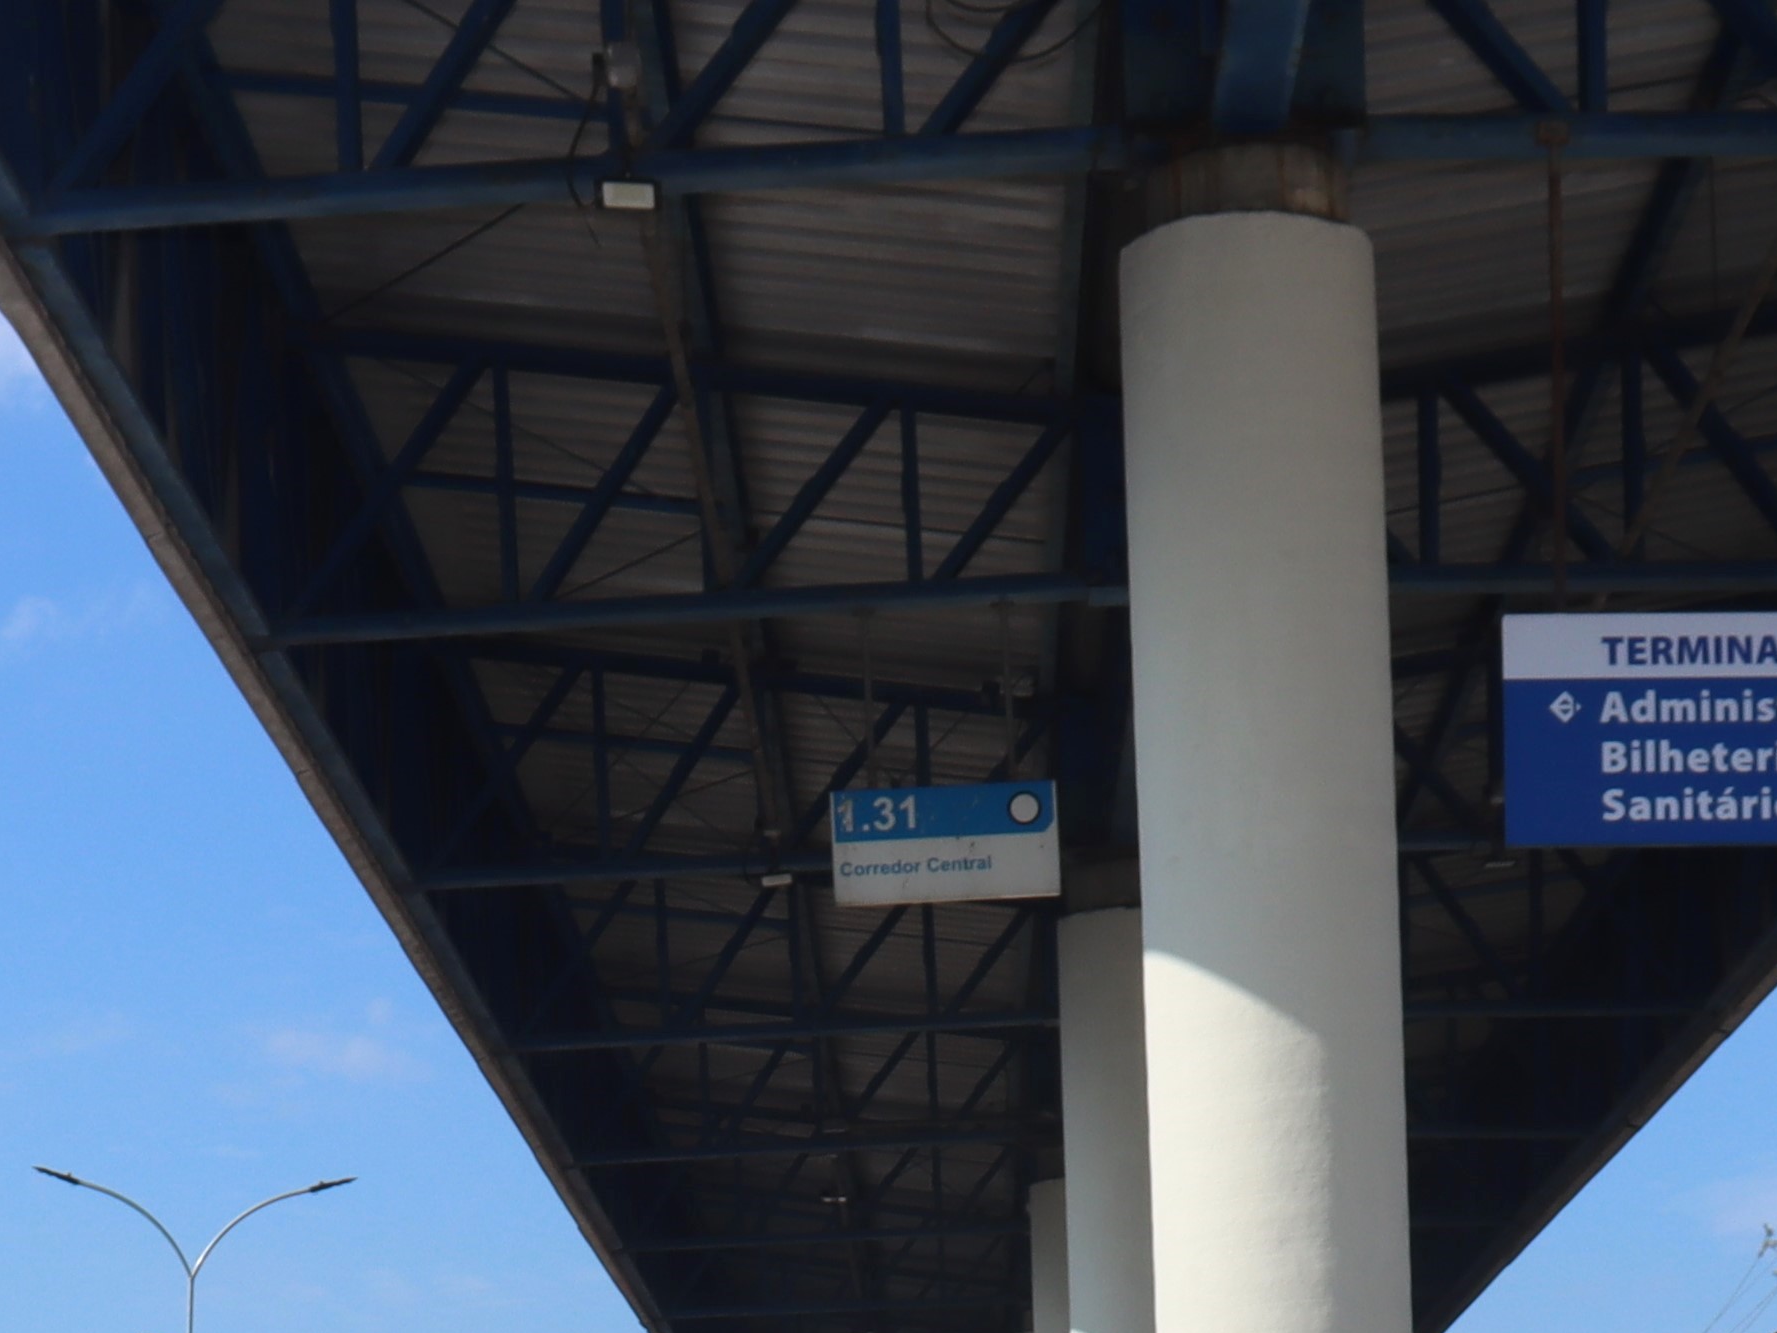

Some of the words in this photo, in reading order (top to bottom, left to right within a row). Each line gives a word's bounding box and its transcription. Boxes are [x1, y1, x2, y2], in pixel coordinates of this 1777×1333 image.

[837, 795, 917, 832] 1.31
[840, 860, 921, 877] Corredor
[927, 855, 992, 872] Central
